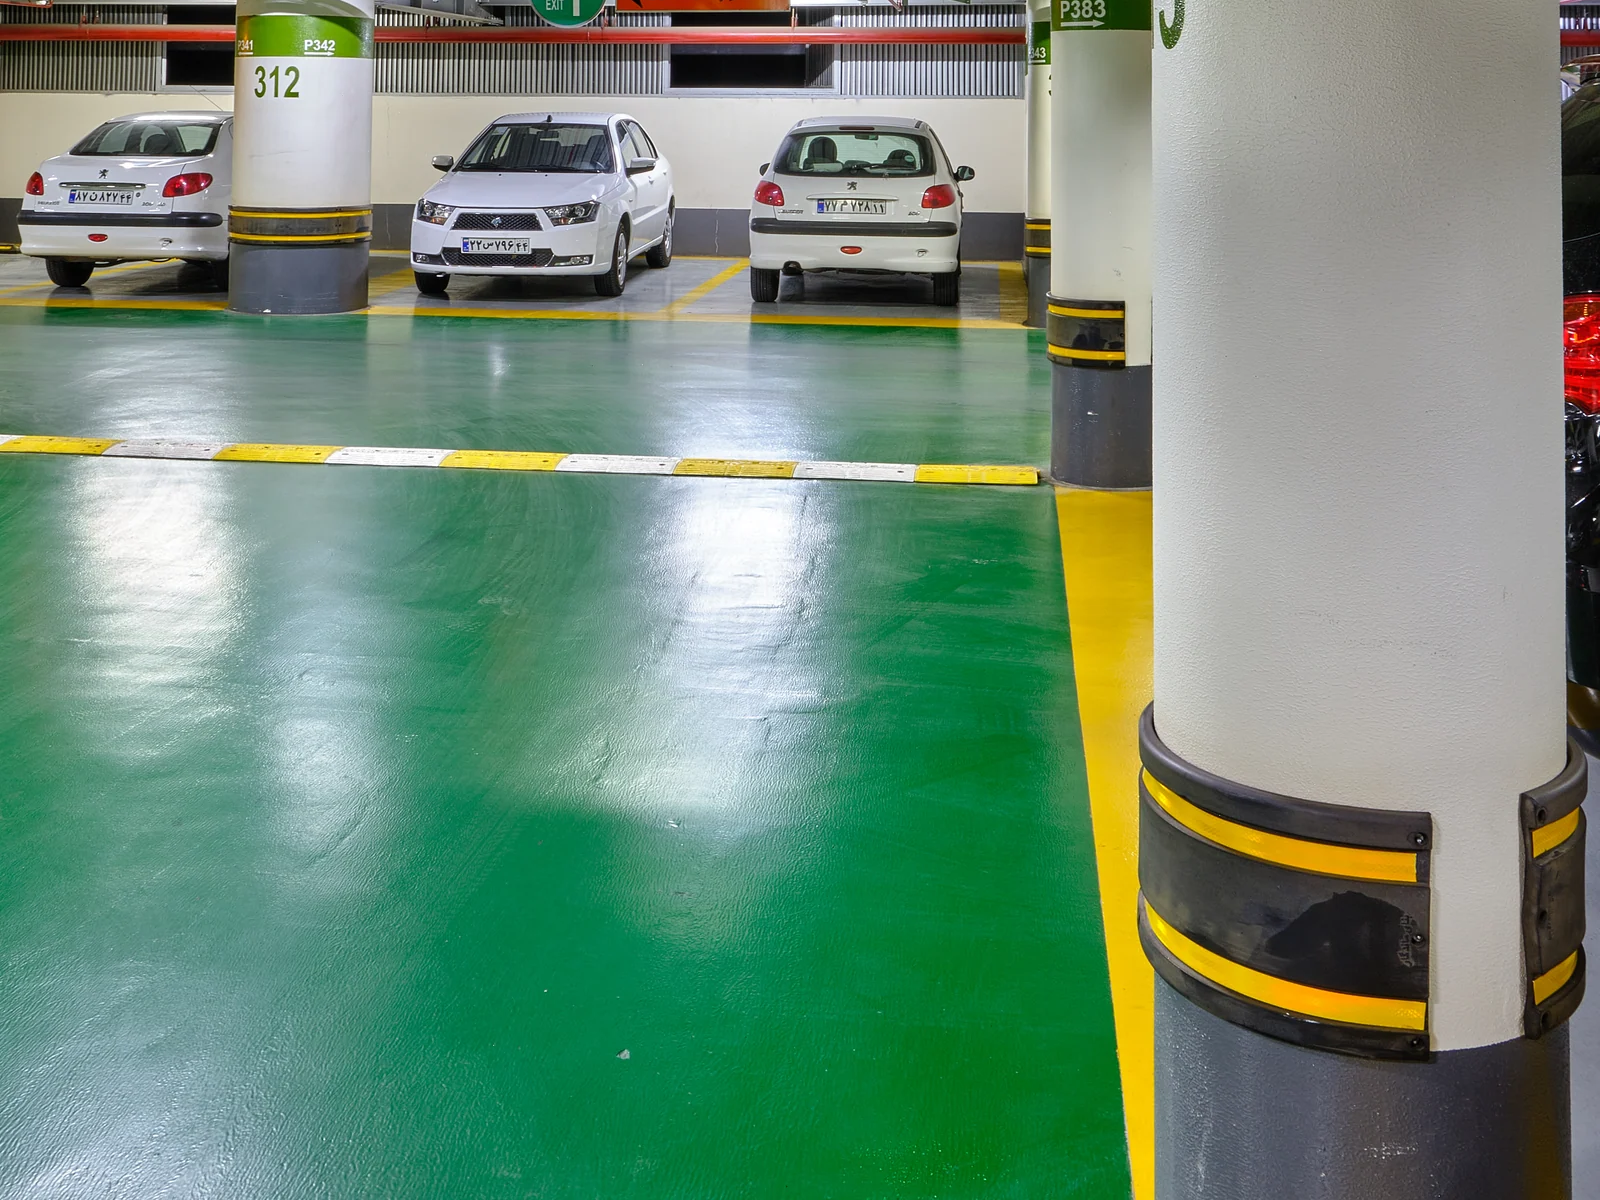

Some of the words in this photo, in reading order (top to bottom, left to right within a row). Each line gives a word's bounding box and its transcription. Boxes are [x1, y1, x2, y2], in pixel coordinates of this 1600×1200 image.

[1060, 0, 1107, 19] P383
[237, 40, 254, 51] P341
[304, 39, 336, 51] P342
[1028, 46, 1047, 59] 343
[254, 65, 300, 98] 312
